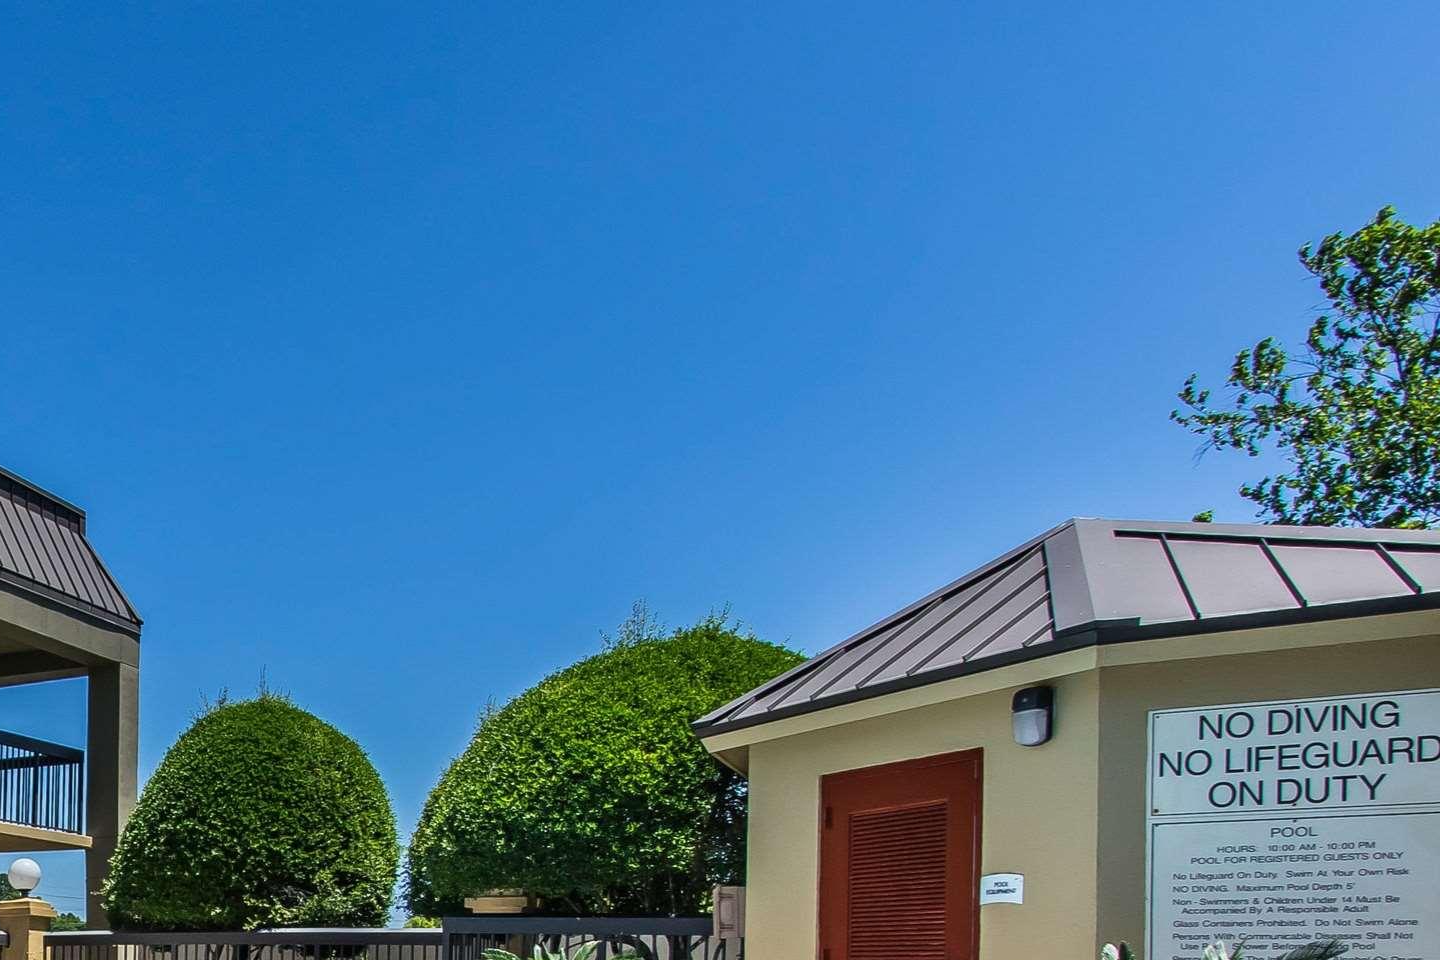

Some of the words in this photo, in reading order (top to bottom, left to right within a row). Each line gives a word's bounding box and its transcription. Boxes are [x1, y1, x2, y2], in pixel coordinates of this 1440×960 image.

[1199, 711, 1254, 740] NO
[1267, 700, 1400, 736] DIVING
[1159, 749, 1213, 777] NO
[1225, 735, 1440, 773] LIFEGUARD
[1208, 781, 1264, 808] ON
[1276, 774, 1387, 805] DUTY
[1270, 826, 1319, 838] POOL
[1268, 844, 1295, 852] 10:00
[1327, 842, 1356, 850] 10:00
[1358, 841, 1377, 849] PM
[1191, 857, 1222, 865] POOL
[1223, 856, 1247, 864] FOR
[1249, 853, 1320, 863] REGISTERED
[1323, 852, 1370, 861] GUESTS
[1372, 851, 1405, 860] ONLY
[1190, 872, 1234, 881] Lifeguard
[1237, 871, 1252, 879] On
[1286, 870, 1314, 878] Swim
[1358, 868, 1384, 876] Own
[1236, 884, 1285, 892] Maximum
[1287, 883, 1310, 891] Pool
[1312, 882, 1343, 892] Depth
[1252, 897, 1260, 905] &
[1263, 896, 1305, 905] Children
[1307, 896, 1337, 904] Under
[1356, 895, 1382, 903] Must
[1385, 895, 1401, 903] Be
[1182, 907, 1247, 915] Accompanied
[1249, 906, 1263, 915] By
[1277, 905, 1339, 914] Responsible
[1173, 920, 1200, 928] Glass
[1202, 919, 1253, 928] Containers
[1314, 919, 1330, 927] Do
[1355, 918, 1384, 926] Swim
[1173, 933, 1210, 941] Persons
[1213, 932, 1236, 940] With
[1238, 932, 1312, 941] Communicable
[1315, 932, 1362, 940] Diseases
[1366, 932, 1392, 940] Shall
[1394, 932, 1414, 940] Not
[1180, 943, 1200, 951] Use
